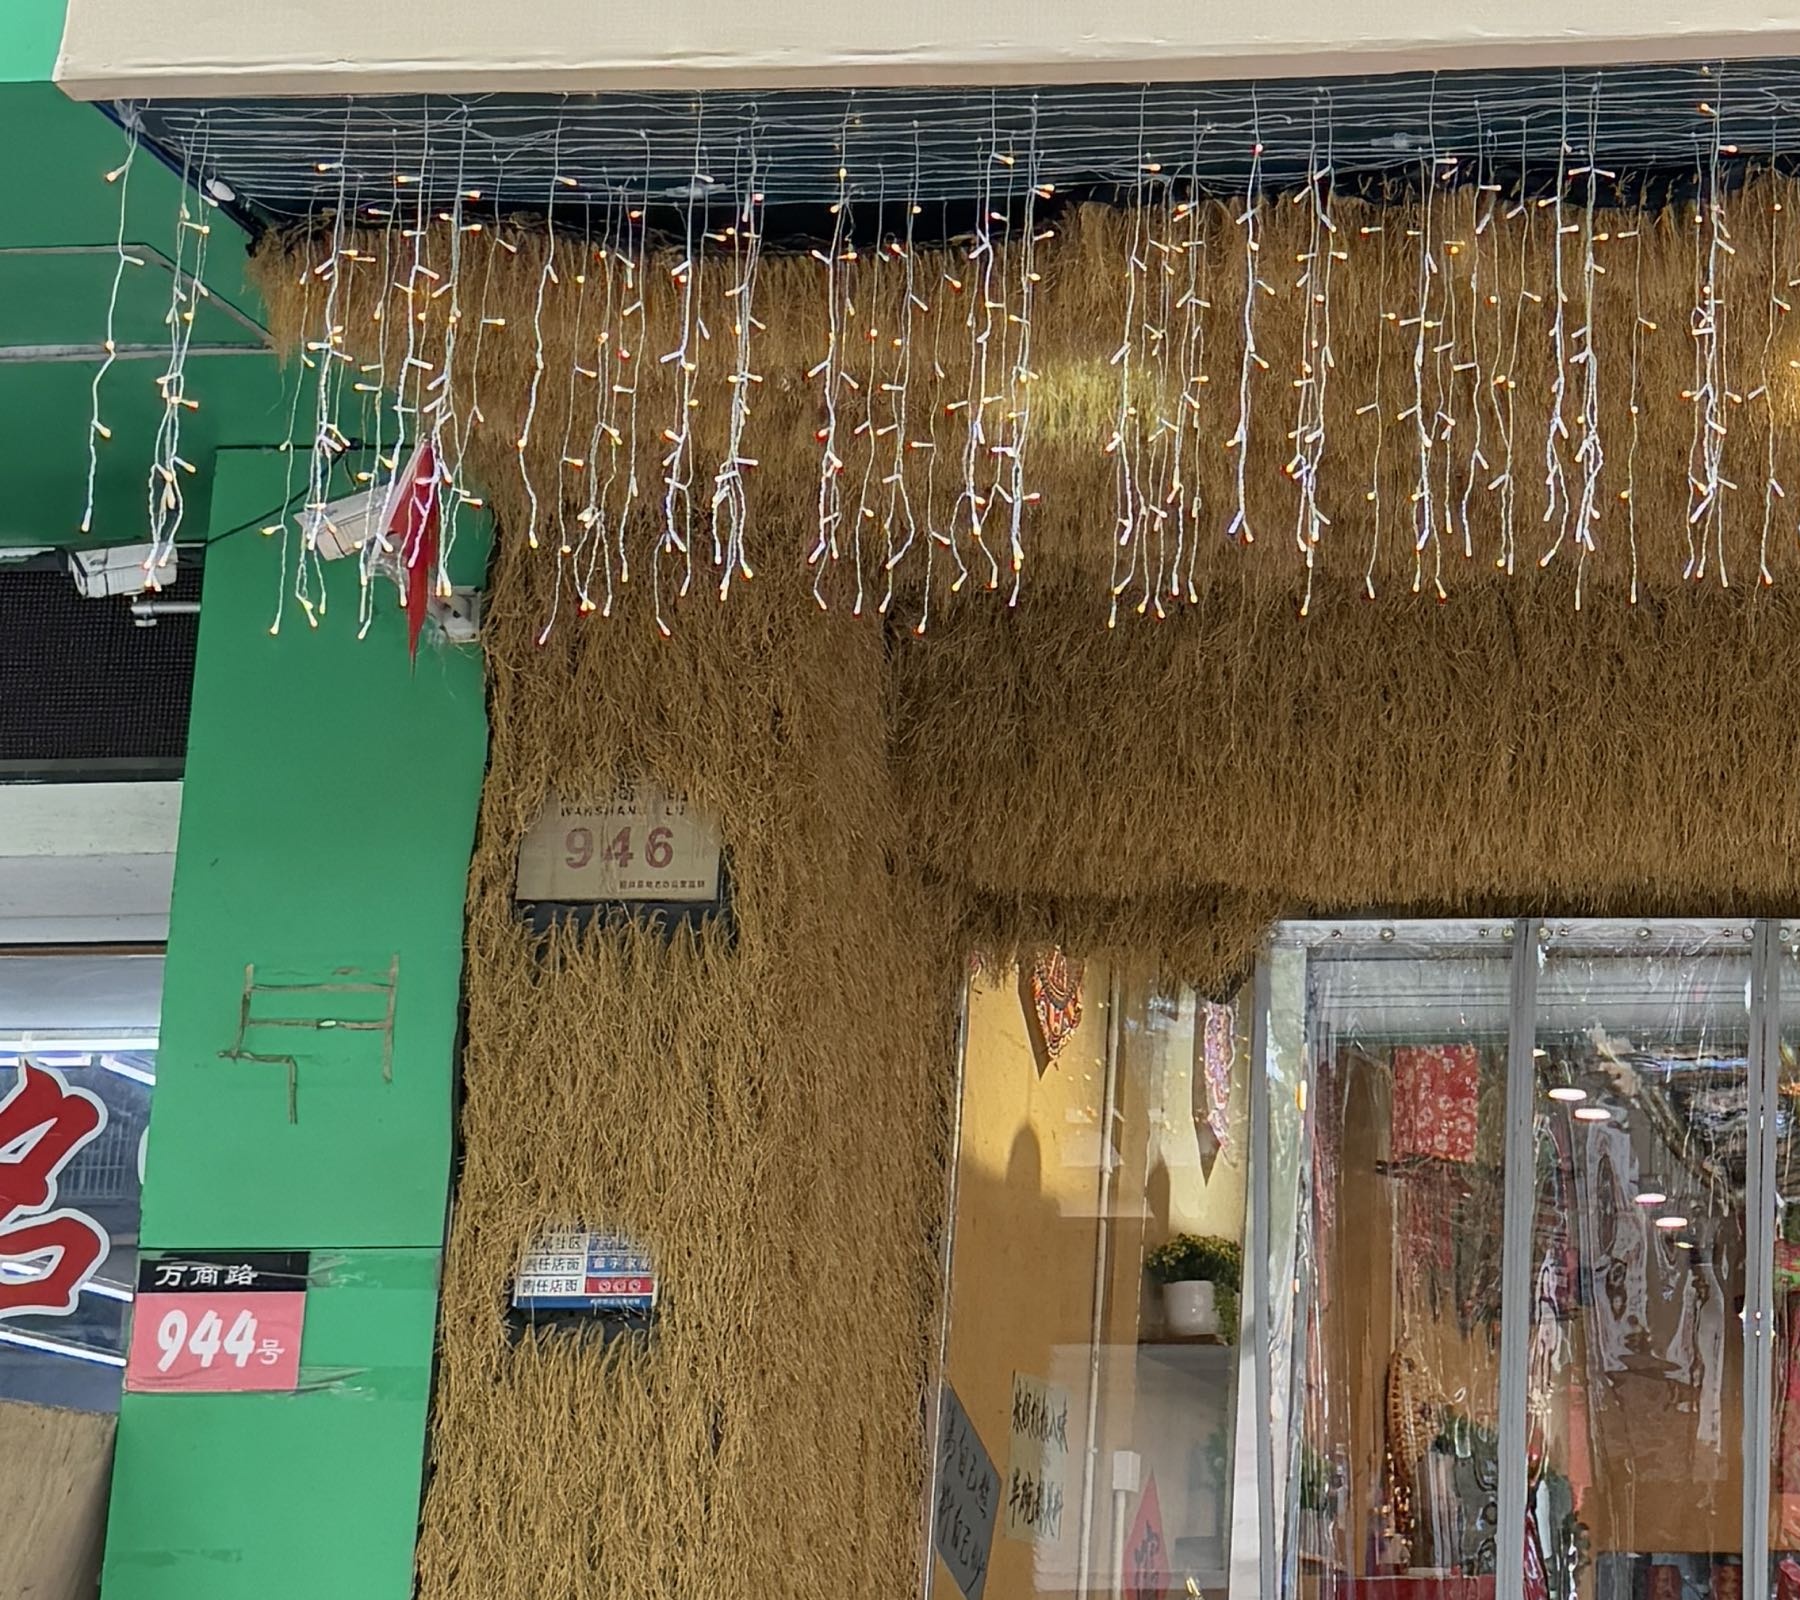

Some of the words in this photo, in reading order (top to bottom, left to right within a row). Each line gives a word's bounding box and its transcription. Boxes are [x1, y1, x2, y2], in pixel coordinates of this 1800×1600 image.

[565, 826, 675, 870] 946
[155, 1263, 258, 1288] 万商路
[156, 1308, 286, 1373] 944号
